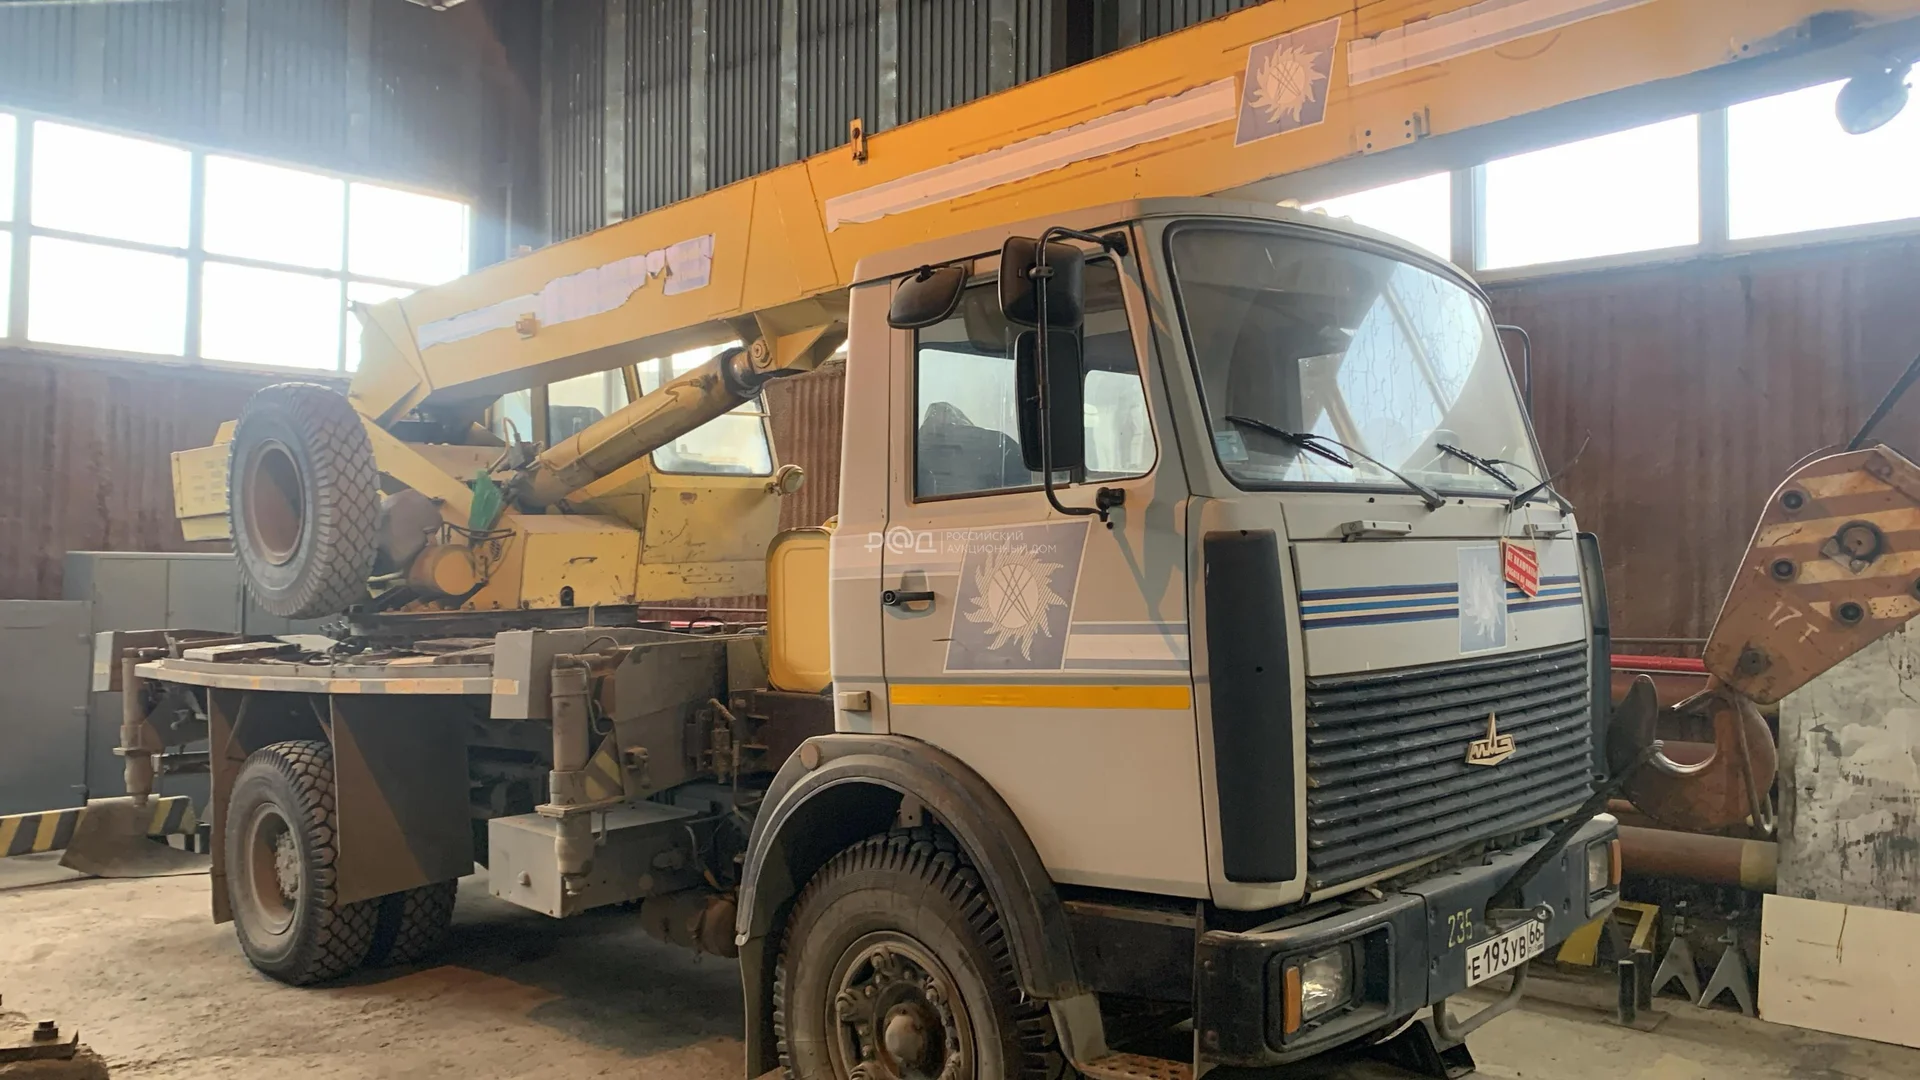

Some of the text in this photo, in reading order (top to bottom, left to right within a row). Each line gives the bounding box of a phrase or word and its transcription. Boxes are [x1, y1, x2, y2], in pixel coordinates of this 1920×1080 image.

[1767, 601, 1803, 627] 17
[1447, 908, 1473, 948] 235
[1529, 920, 1541, 945] 66
